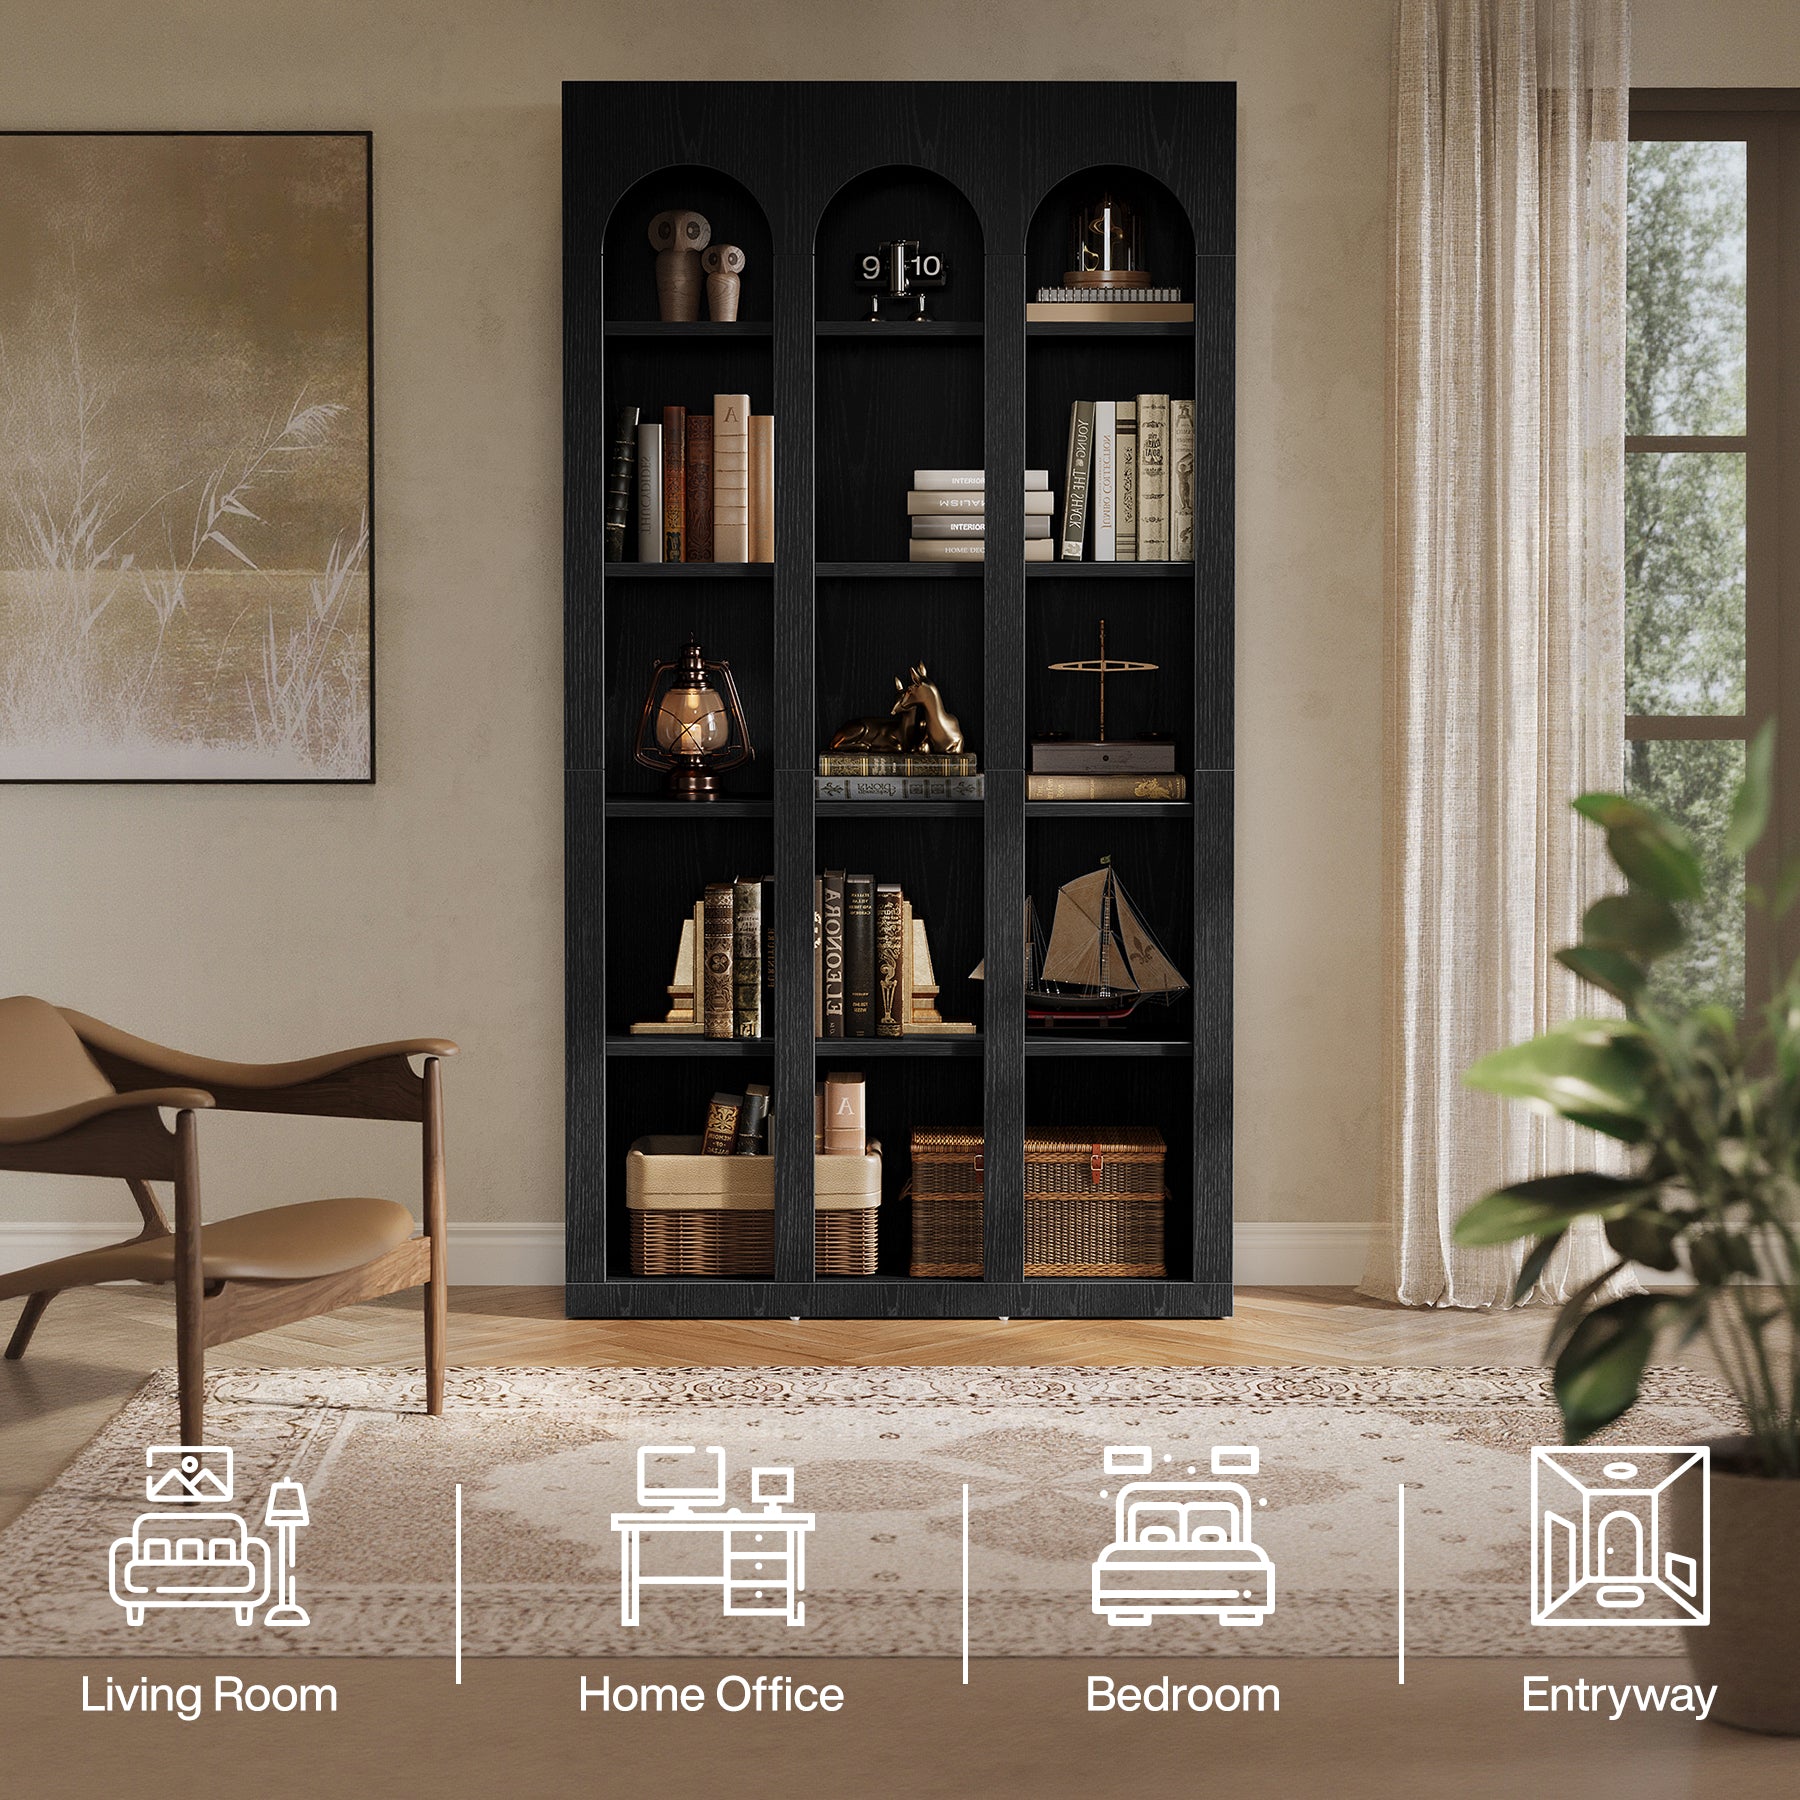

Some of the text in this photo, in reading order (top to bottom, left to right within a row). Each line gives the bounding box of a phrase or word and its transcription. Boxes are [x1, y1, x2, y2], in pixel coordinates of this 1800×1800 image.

[862, 255, 940, 280] 9 10
[724, 406, 739, 423] A
[835, 1097, 856, 1116] A
